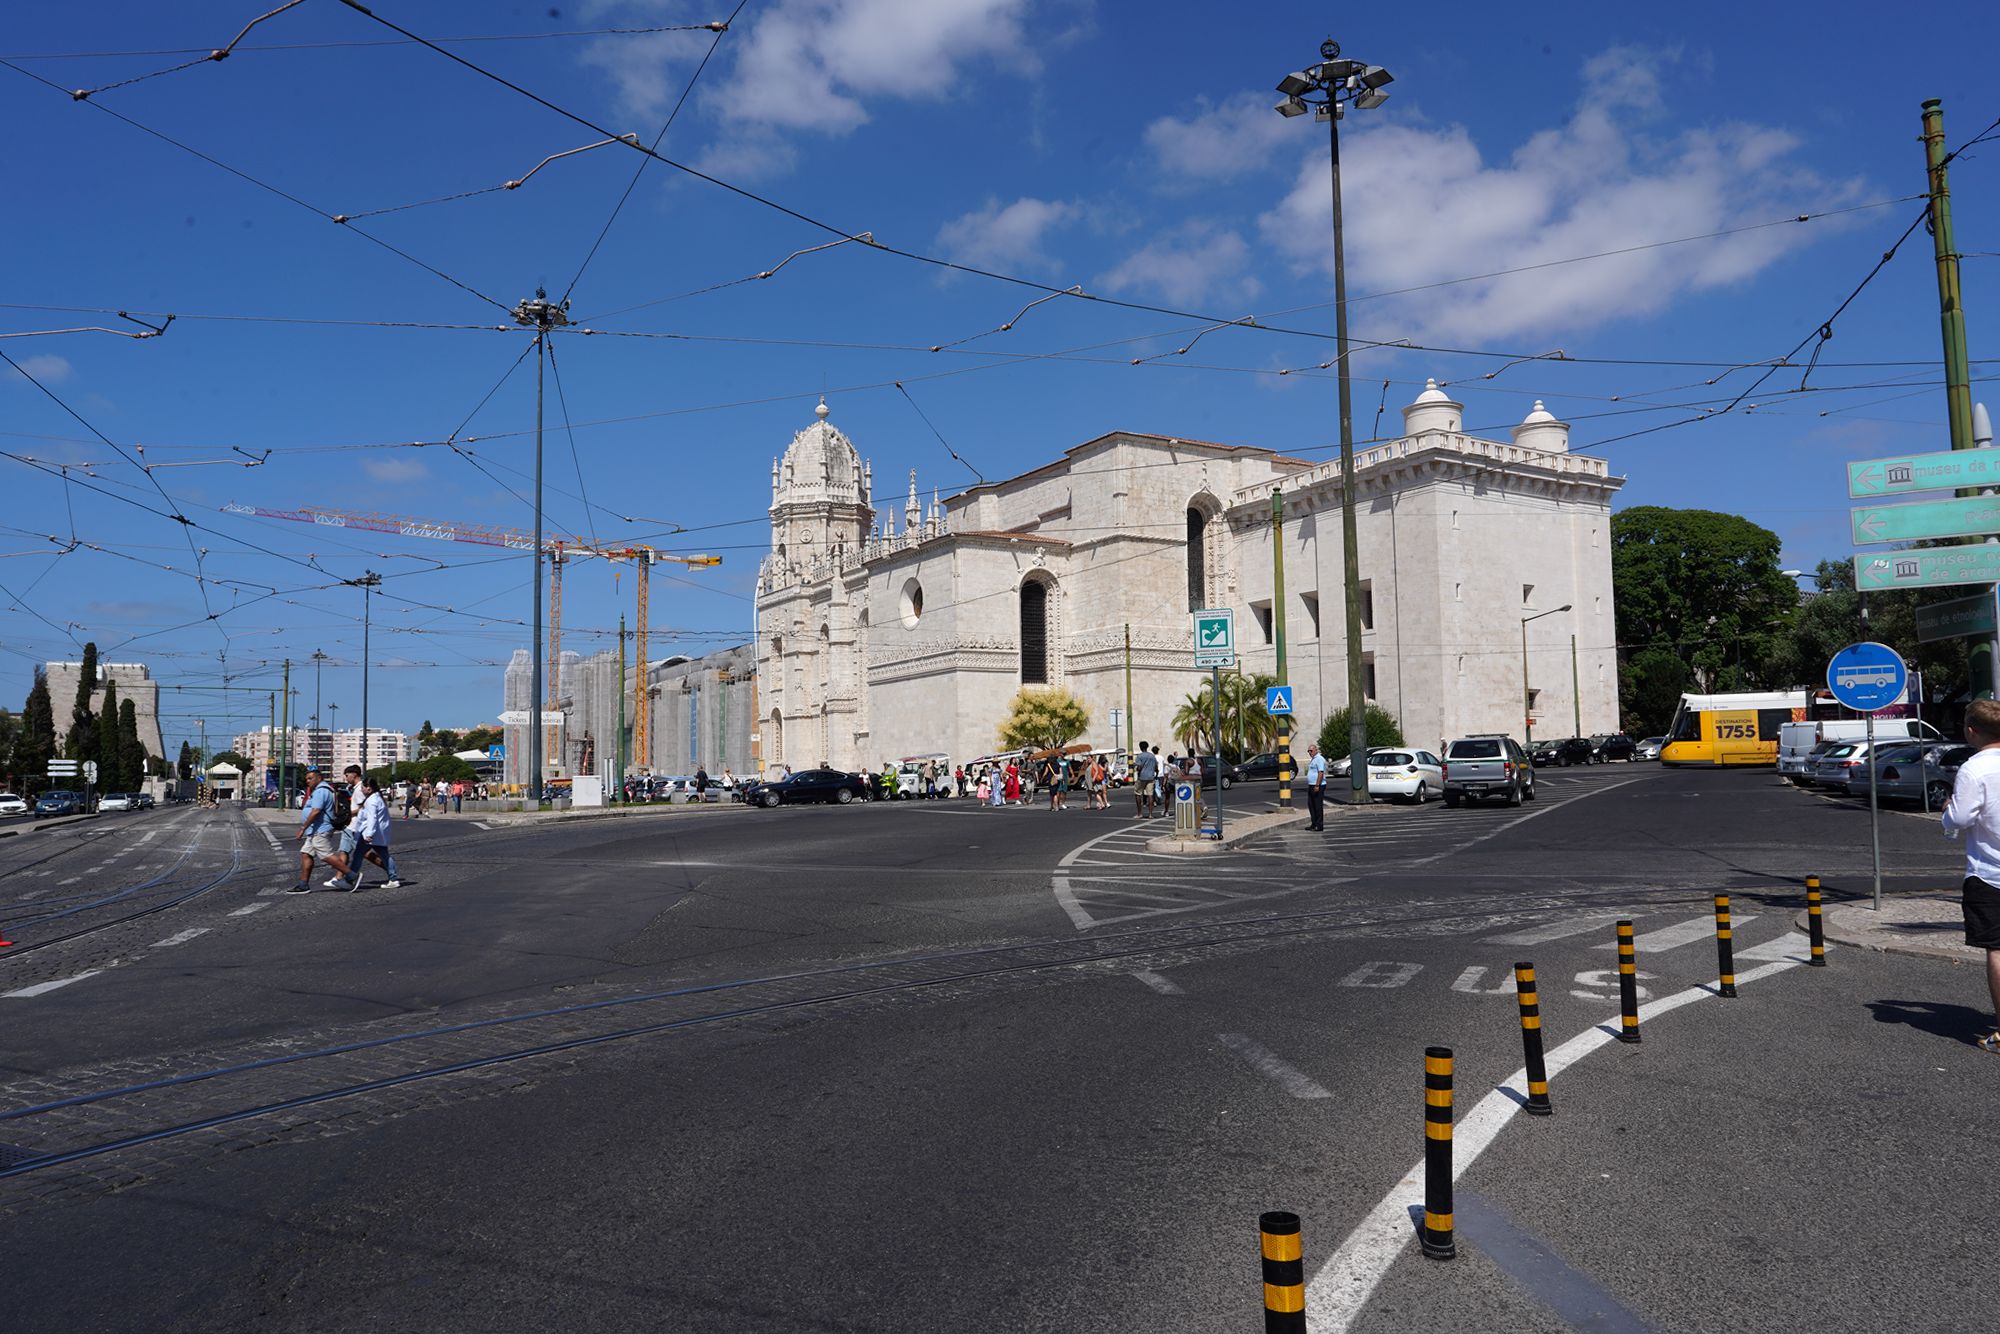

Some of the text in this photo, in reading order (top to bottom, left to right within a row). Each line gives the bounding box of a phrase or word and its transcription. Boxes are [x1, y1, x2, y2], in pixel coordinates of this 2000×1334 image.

[1915, 463, 1961, 478] museu
[1968, 460, 1987, 473] da
[1923, 553, 1977, 566] museu
[1930, 566, 2000, 580] de arqu
[1715, 724, 1757, 739] 1755
